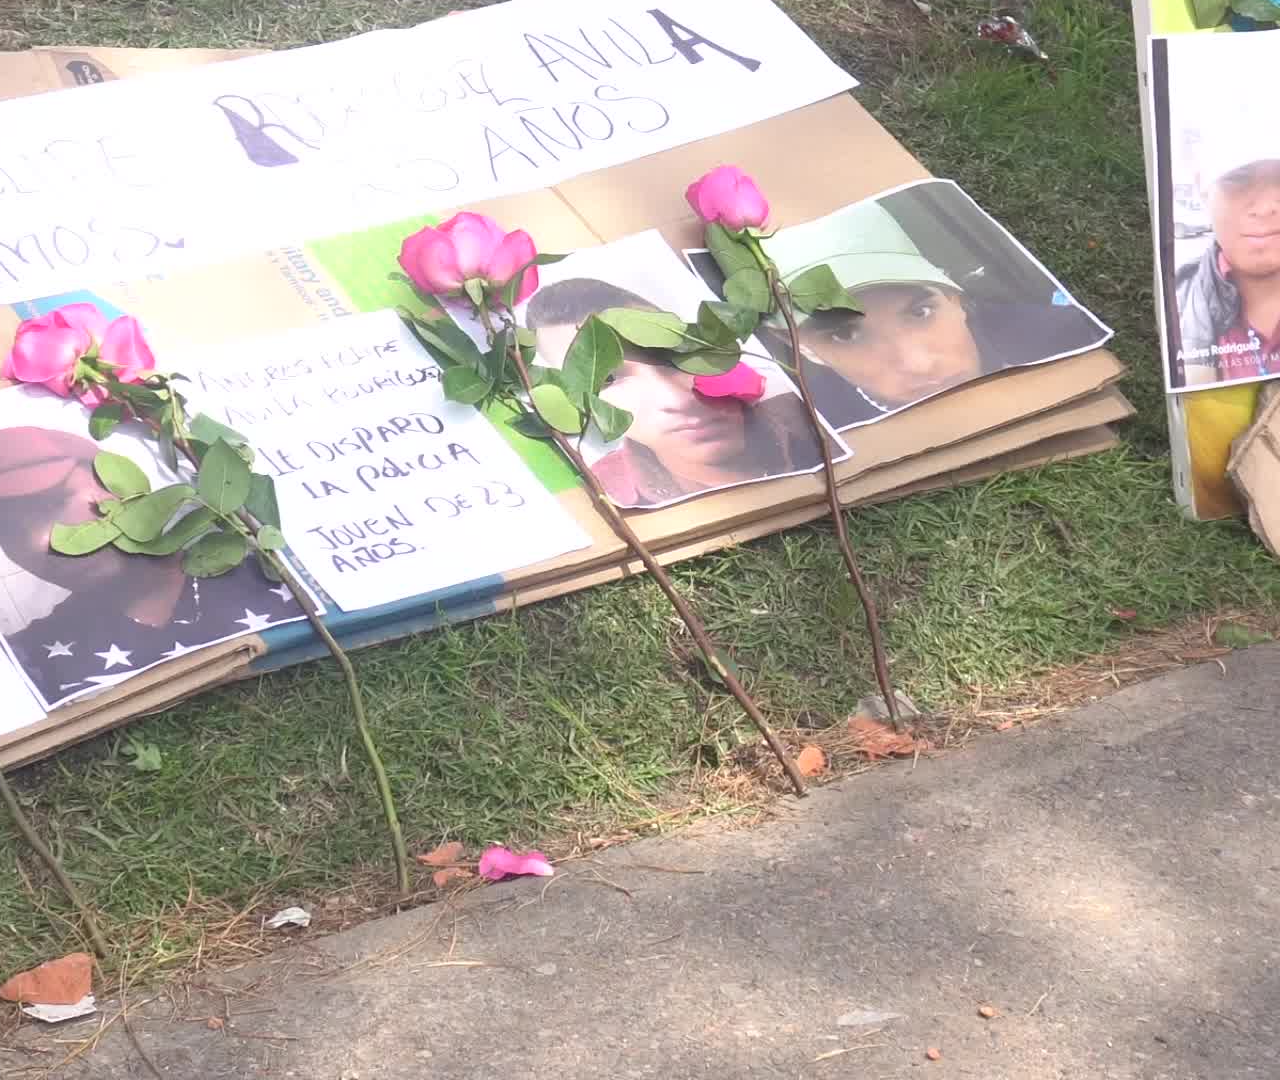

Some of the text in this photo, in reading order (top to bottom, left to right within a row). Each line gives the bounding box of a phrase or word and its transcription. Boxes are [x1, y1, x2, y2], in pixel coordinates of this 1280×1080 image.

[523, 8, 762, 82] AVILA
[315, 287, 353, 318] and
[301, 480, 349, 499] LA
